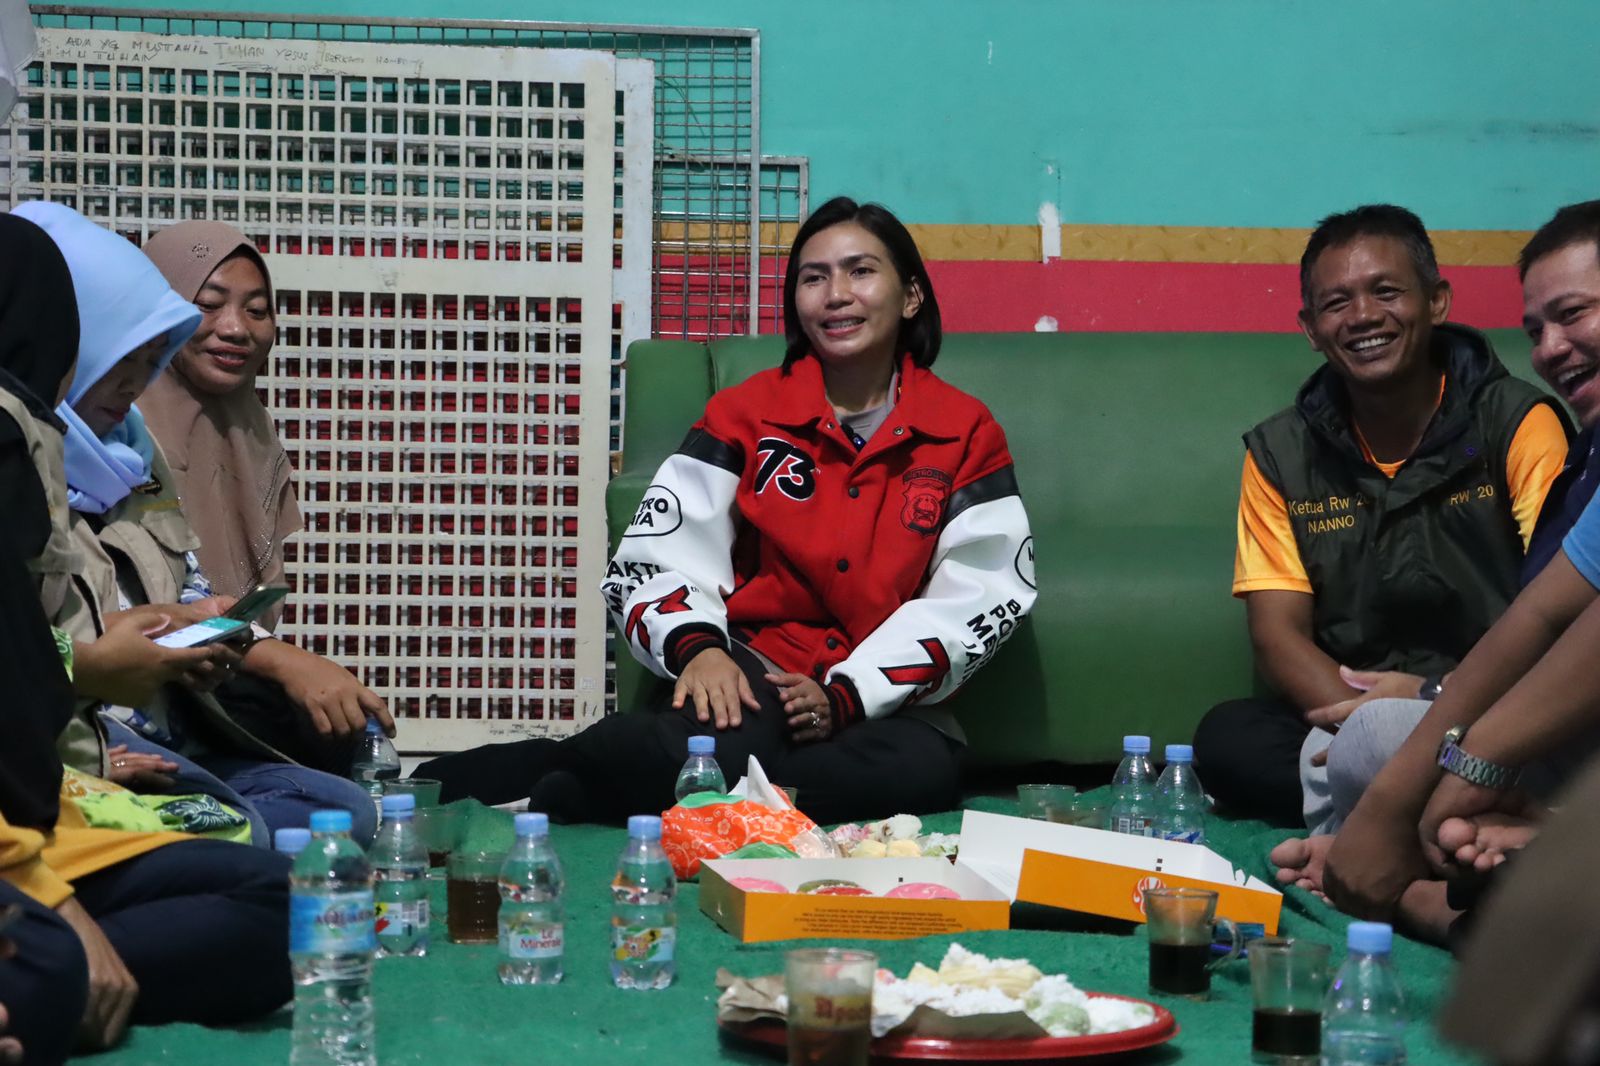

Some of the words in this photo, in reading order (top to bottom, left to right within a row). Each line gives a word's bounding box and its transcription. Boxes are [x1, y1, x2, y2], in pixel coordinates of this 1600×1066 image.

[754, 436, 816, 501] 73
[1450, 490, 1470, 505] RW
[1477, 484, 1494, 499] 20
[1288, 500, 1324, 516] Ketua
[1308, 514, 1355, 534] NANNO
